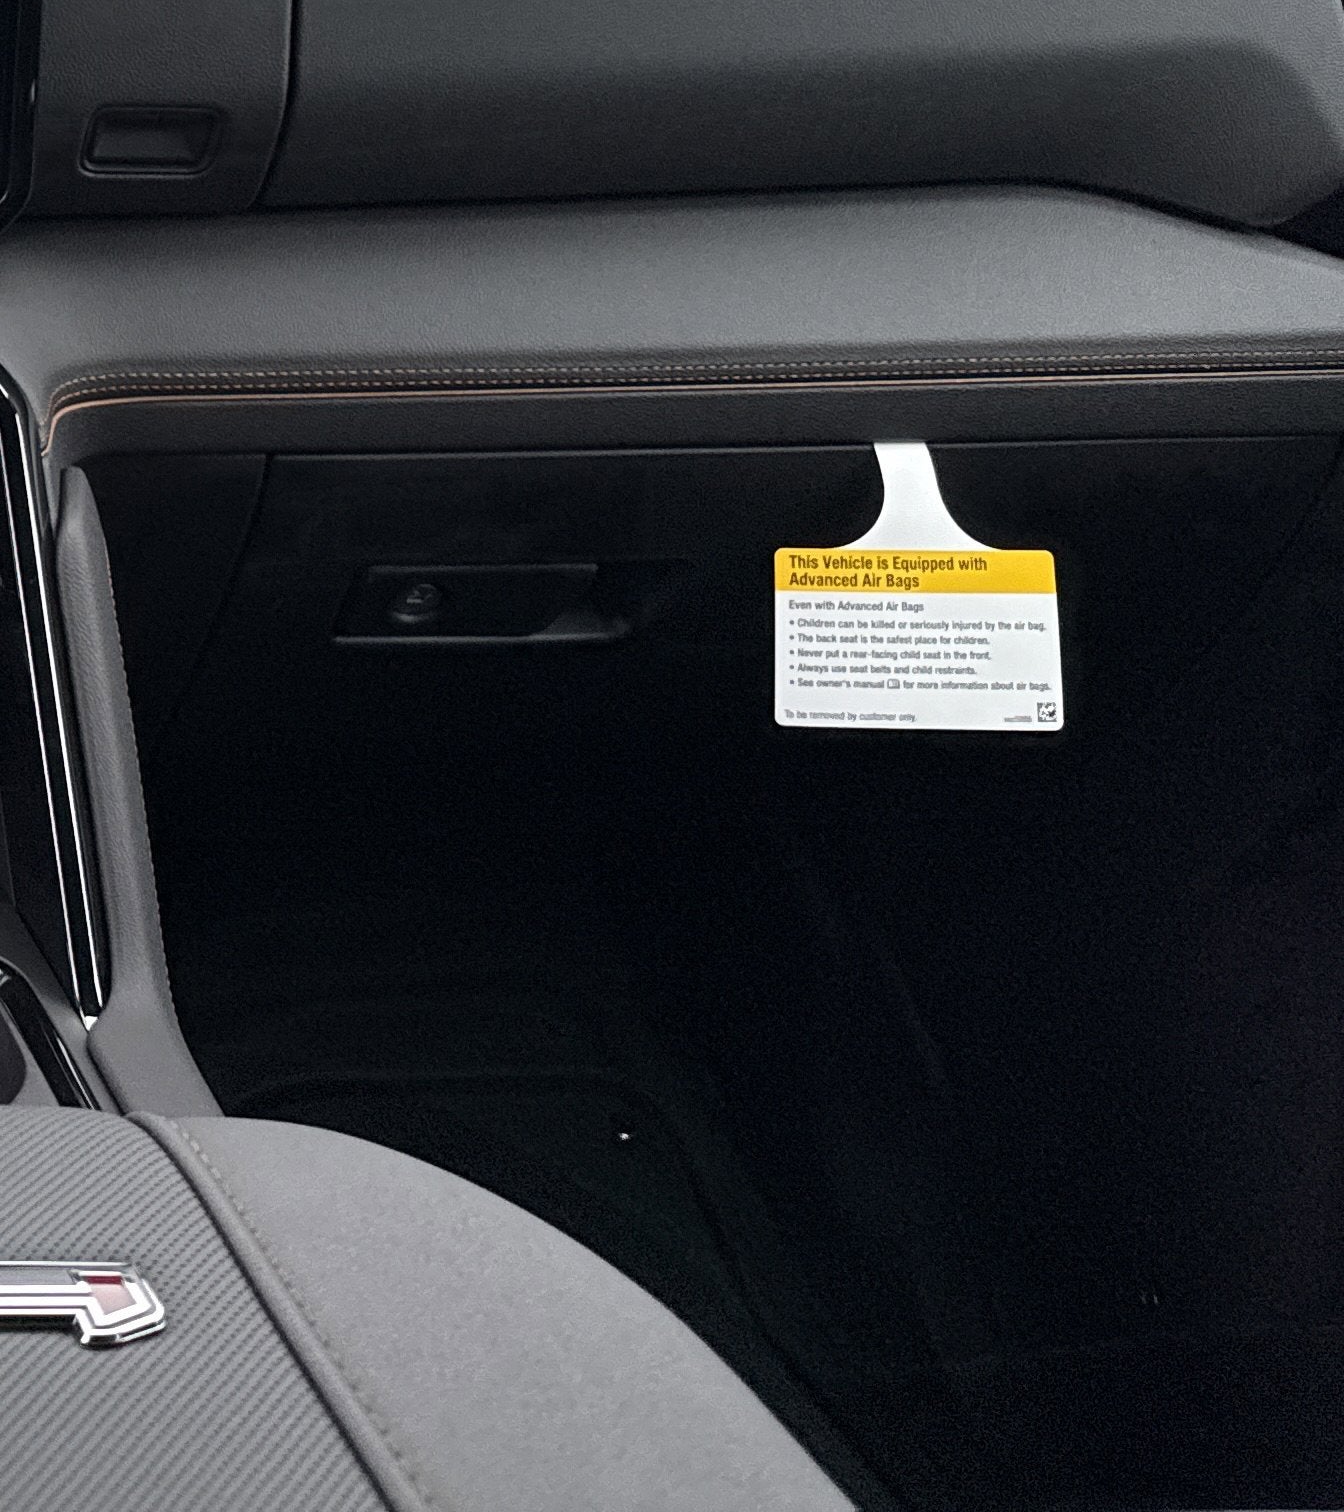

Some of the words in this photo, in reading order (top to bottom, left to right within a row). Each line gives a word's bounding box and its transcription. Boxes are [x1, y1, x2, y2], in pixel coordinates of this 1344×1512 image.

[789, 555, 818, 569] This
[823, 556, 872, 569] Vehicle
[877, 556, 888, 569] is
[892, 556, 954, 573] Equipped
[958, 557, 987, 571] with
[789, 572, 857, 586] Advanced
[862, 572, 882, 587] Air
[886, 574, 919, 590] Bags
[789, 600, 811, 610] Even
[815, 601, 835, 610] with
[838, 601, 883, 611] Advanced
[886, 602, 898, 611] Air
[902, 602, 924, 613] Bags
[798, 618, 835, 628] Children
[858, 620, 868, 628] be
[871, 620, 895, 629] killed
[910, 621, 949, 631] seriously
[952, 620, 982, 631] injured
[985, 622, 995, 631] by
[998, 622, 1011, 630] the
[1014, 622, 1025, 630] air
[1028, 622, 1046, 632] bag.
[798, 633, 813, 642] The
[816, 634, 836, 643] back
[840, 634, 858, 643] seat
[860, 634, 868, 643] is
[870, 634, 884, 644] the
[887, 635, 912, 644] safest
[914, 636, 937, 645] place
[940, 636, 950, 644] for
[954, 636, 990, 644] children.
[798, 649, 823, 657] Never
[826, 649, 839, 659] put
[850, 649, 897, 660] rear-facing
[900, 650, 920, 659] child
[923, 651, 941, 659] seat
[944, 651, 951, 659] in
[954, 652, 967, 660] the
[798, 664, 828, 674] Always
[850, 665, 868, 673] seat
[894, 666, 909, 674] and
[912, 666, 932, 674] child
[798, 678, 813, 687] See
[853, 680, 884, 688] manual
[903, 680, 914, 689] for
[784, 709, 794, 718] To
[797, 710, 807, 718] be
[810, 712, 845, 720] removed
[848, 712, 856, 722] by
[860, 713, 896, 721] customer
